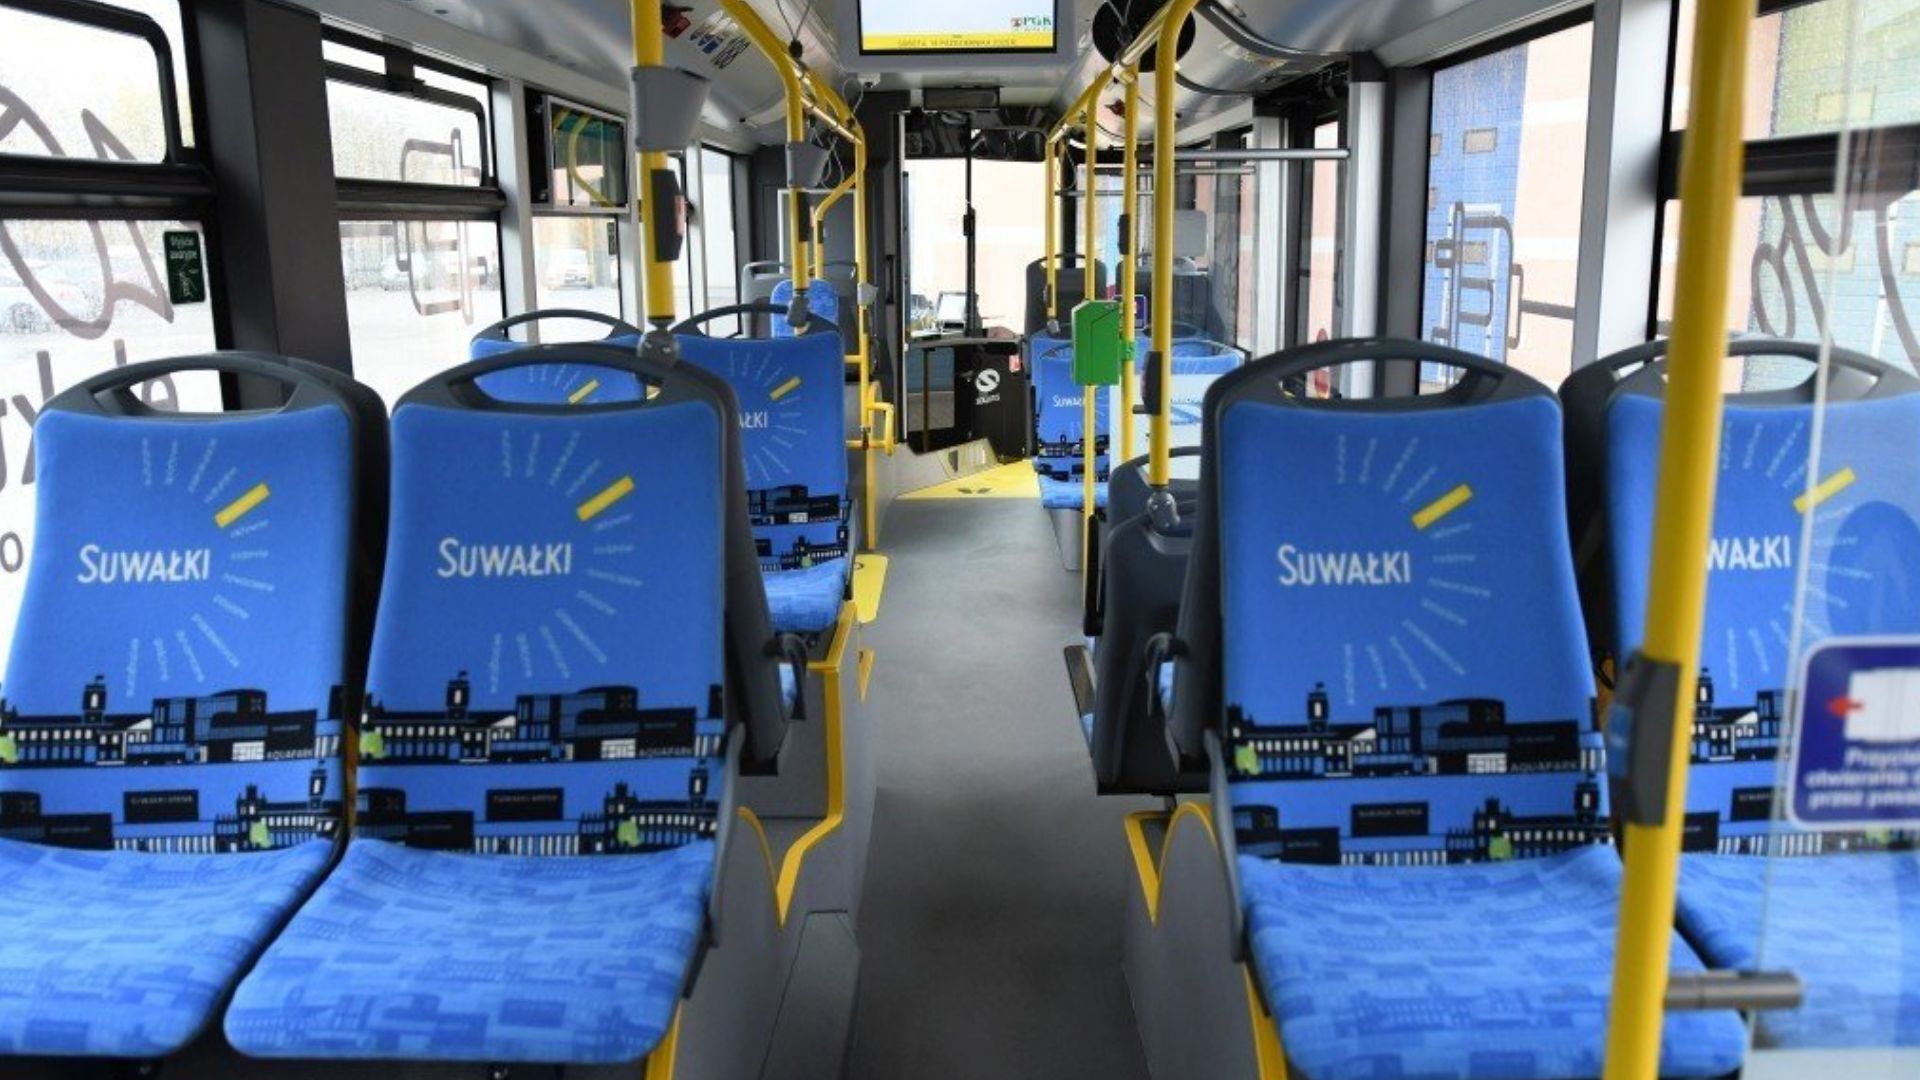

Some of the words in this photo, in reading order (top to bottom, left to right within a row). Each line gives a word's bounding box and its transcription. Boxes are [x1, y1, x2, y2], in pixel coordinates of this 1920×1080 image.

[77, 543, 211, 584] SUWAŁKI
[437, 537, 572, 578] SUWAŁKI
[1277, 544, 1412, 586] SUWAŁKI
[1706, 535, 1792, 571] WAŁKI
